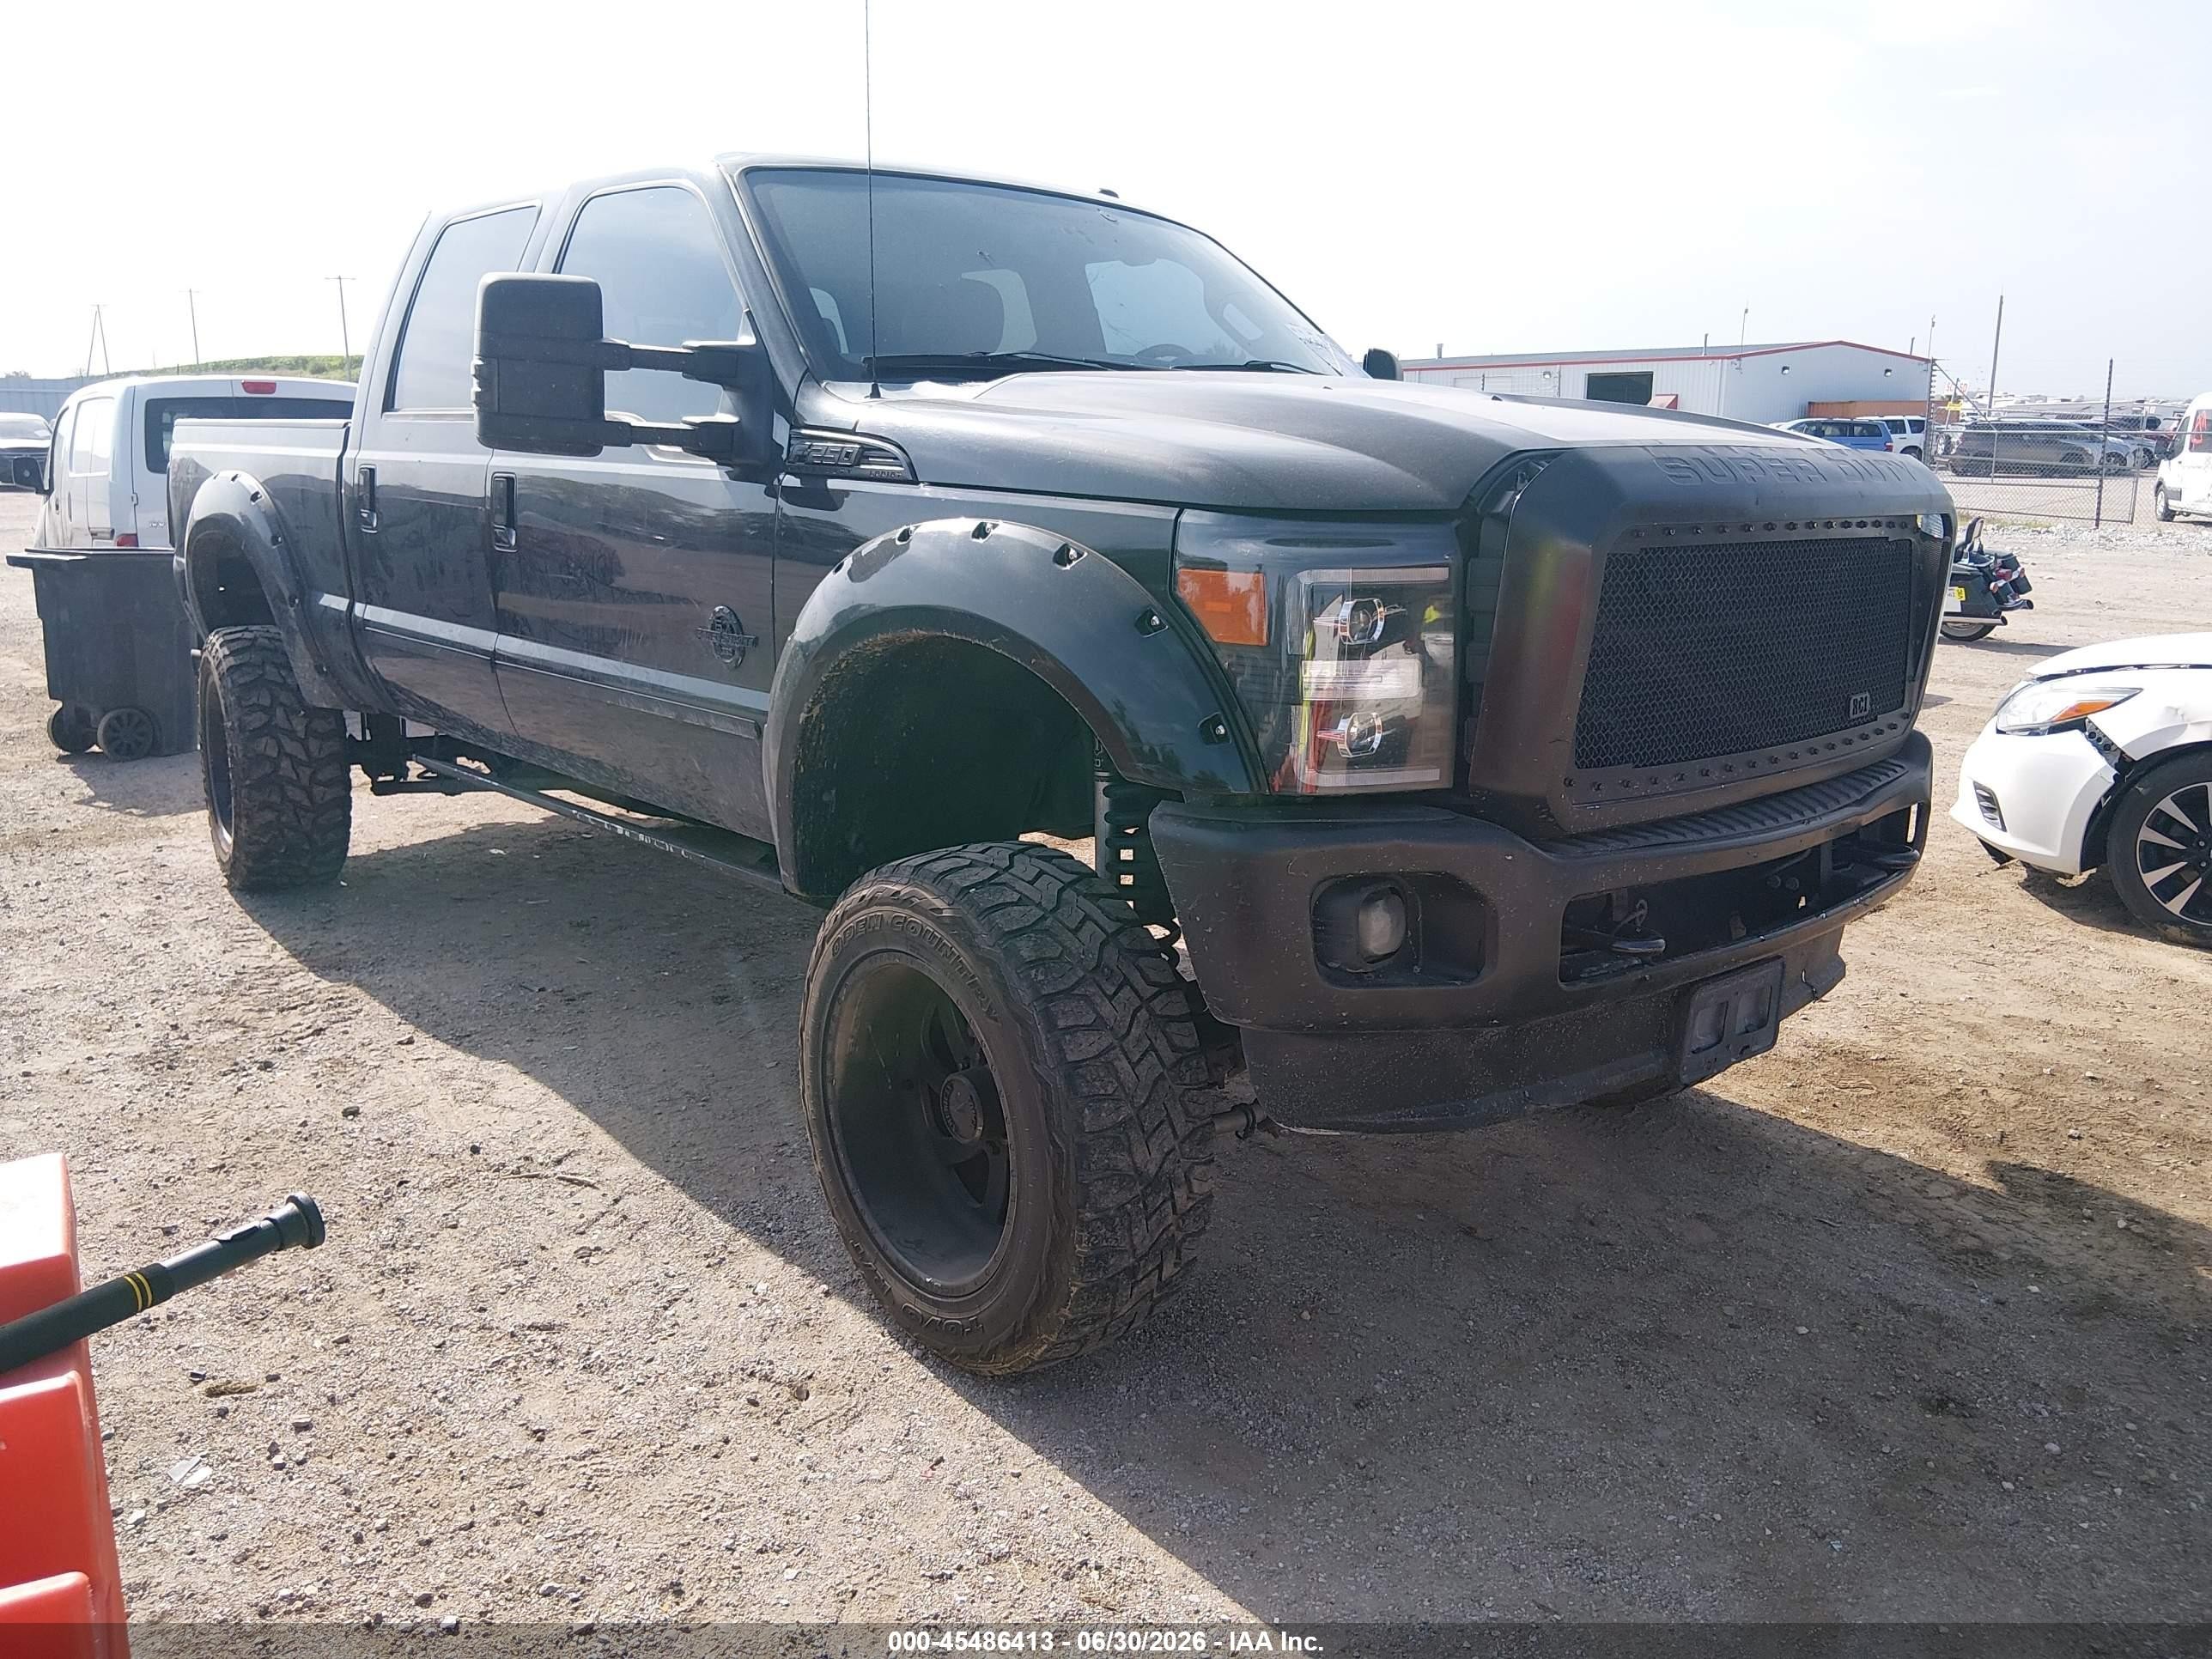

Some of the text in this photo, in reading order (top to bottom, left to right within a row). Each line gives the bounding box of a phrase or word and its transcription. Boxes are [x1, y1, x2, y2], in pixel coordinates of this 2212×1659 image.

[1653, 457, 1917, 486] SUPER DUTY
[832, 913, 999, 1021] OPEN COUNTRY
[902, 1302, 985, 1337] TOYO
